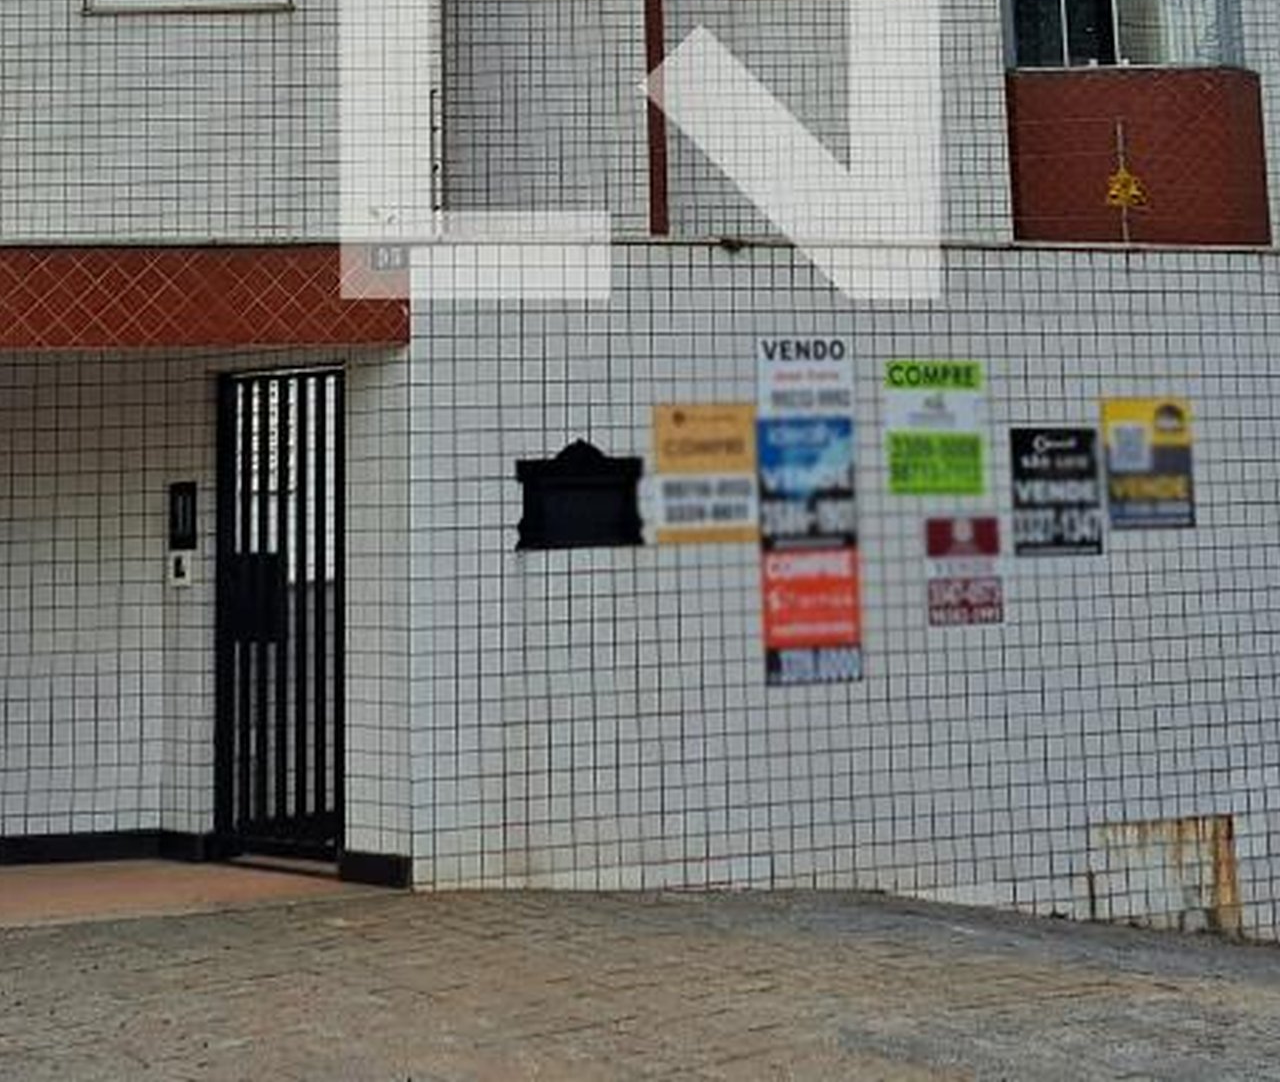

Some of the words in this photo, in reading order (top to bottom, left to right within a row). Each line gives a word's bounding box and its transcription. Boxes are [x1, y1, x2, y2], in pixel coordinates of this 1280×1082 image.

[761, 339, 845, 361] VENDO
[888, 364, 976, 387] COMPRE
[1016, 479, 1097, 502] VENDE
